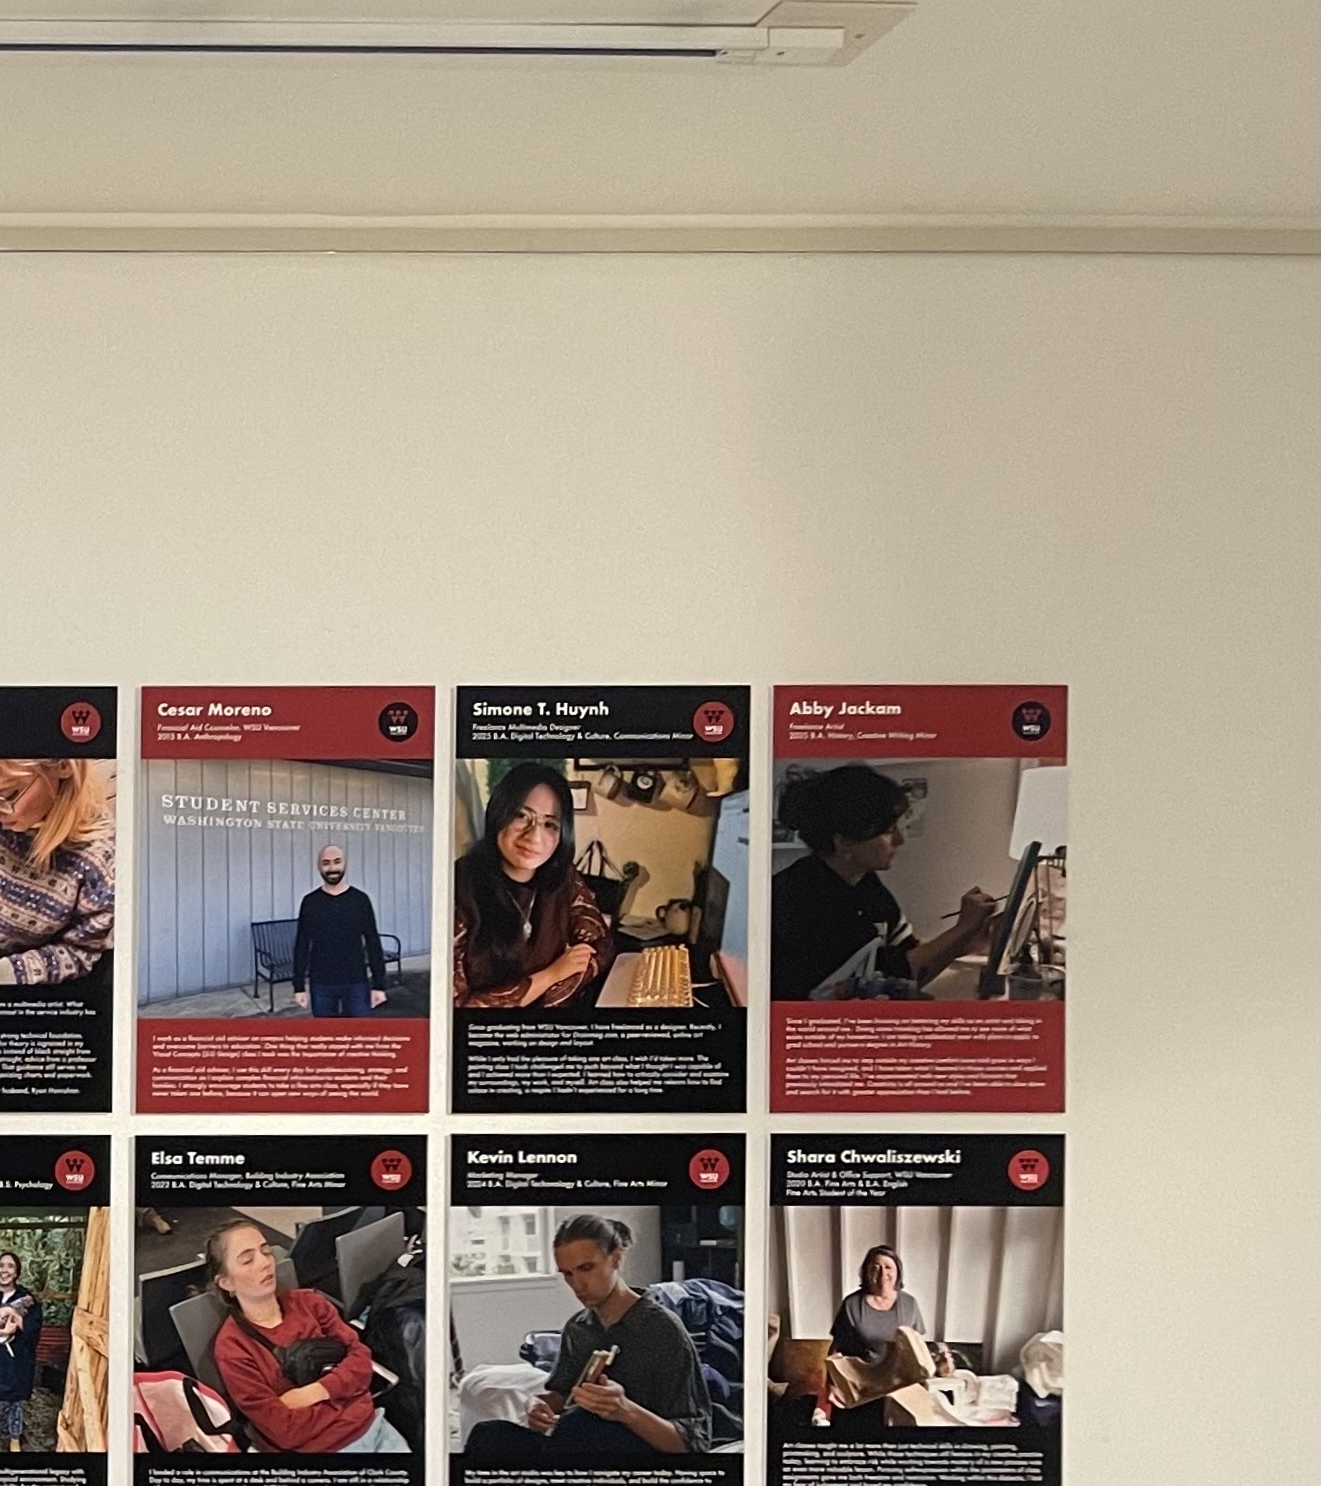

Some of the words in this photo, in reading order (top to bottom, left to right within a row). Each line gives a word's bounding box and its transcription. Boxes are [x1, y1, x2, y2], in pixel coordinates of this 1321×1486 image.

[158, 703, 203, 716] Cesar
[208, 703, 271, 716] Moreno
[473, 702, 532, 715] Simone
[537, 703, 550, 715] T.
[556, 701, 608, 719] Huynh
[790, 701, 834, 718] Abby
[838, 701, 901, 714] Jackam
[161, 794, 260, 814] STUDENT
[267, 802, 348, 818] SERVICES
[353, 807, 406, 821] CENTER
[163, 814, 262, 828] WASHINGTON
[267, 819, 304, 830] STATE
[152, 1151, 183, 1164] Elsa
[187, 1152, 245, 1164] Temme
[468, 1150, 513, 1163] Kevin
[518, 1151, 577, 1163] Lennon
[787, 1150, 835, 1163] Shara
[841, 1150, 960, 1163] Chwaliszewski
